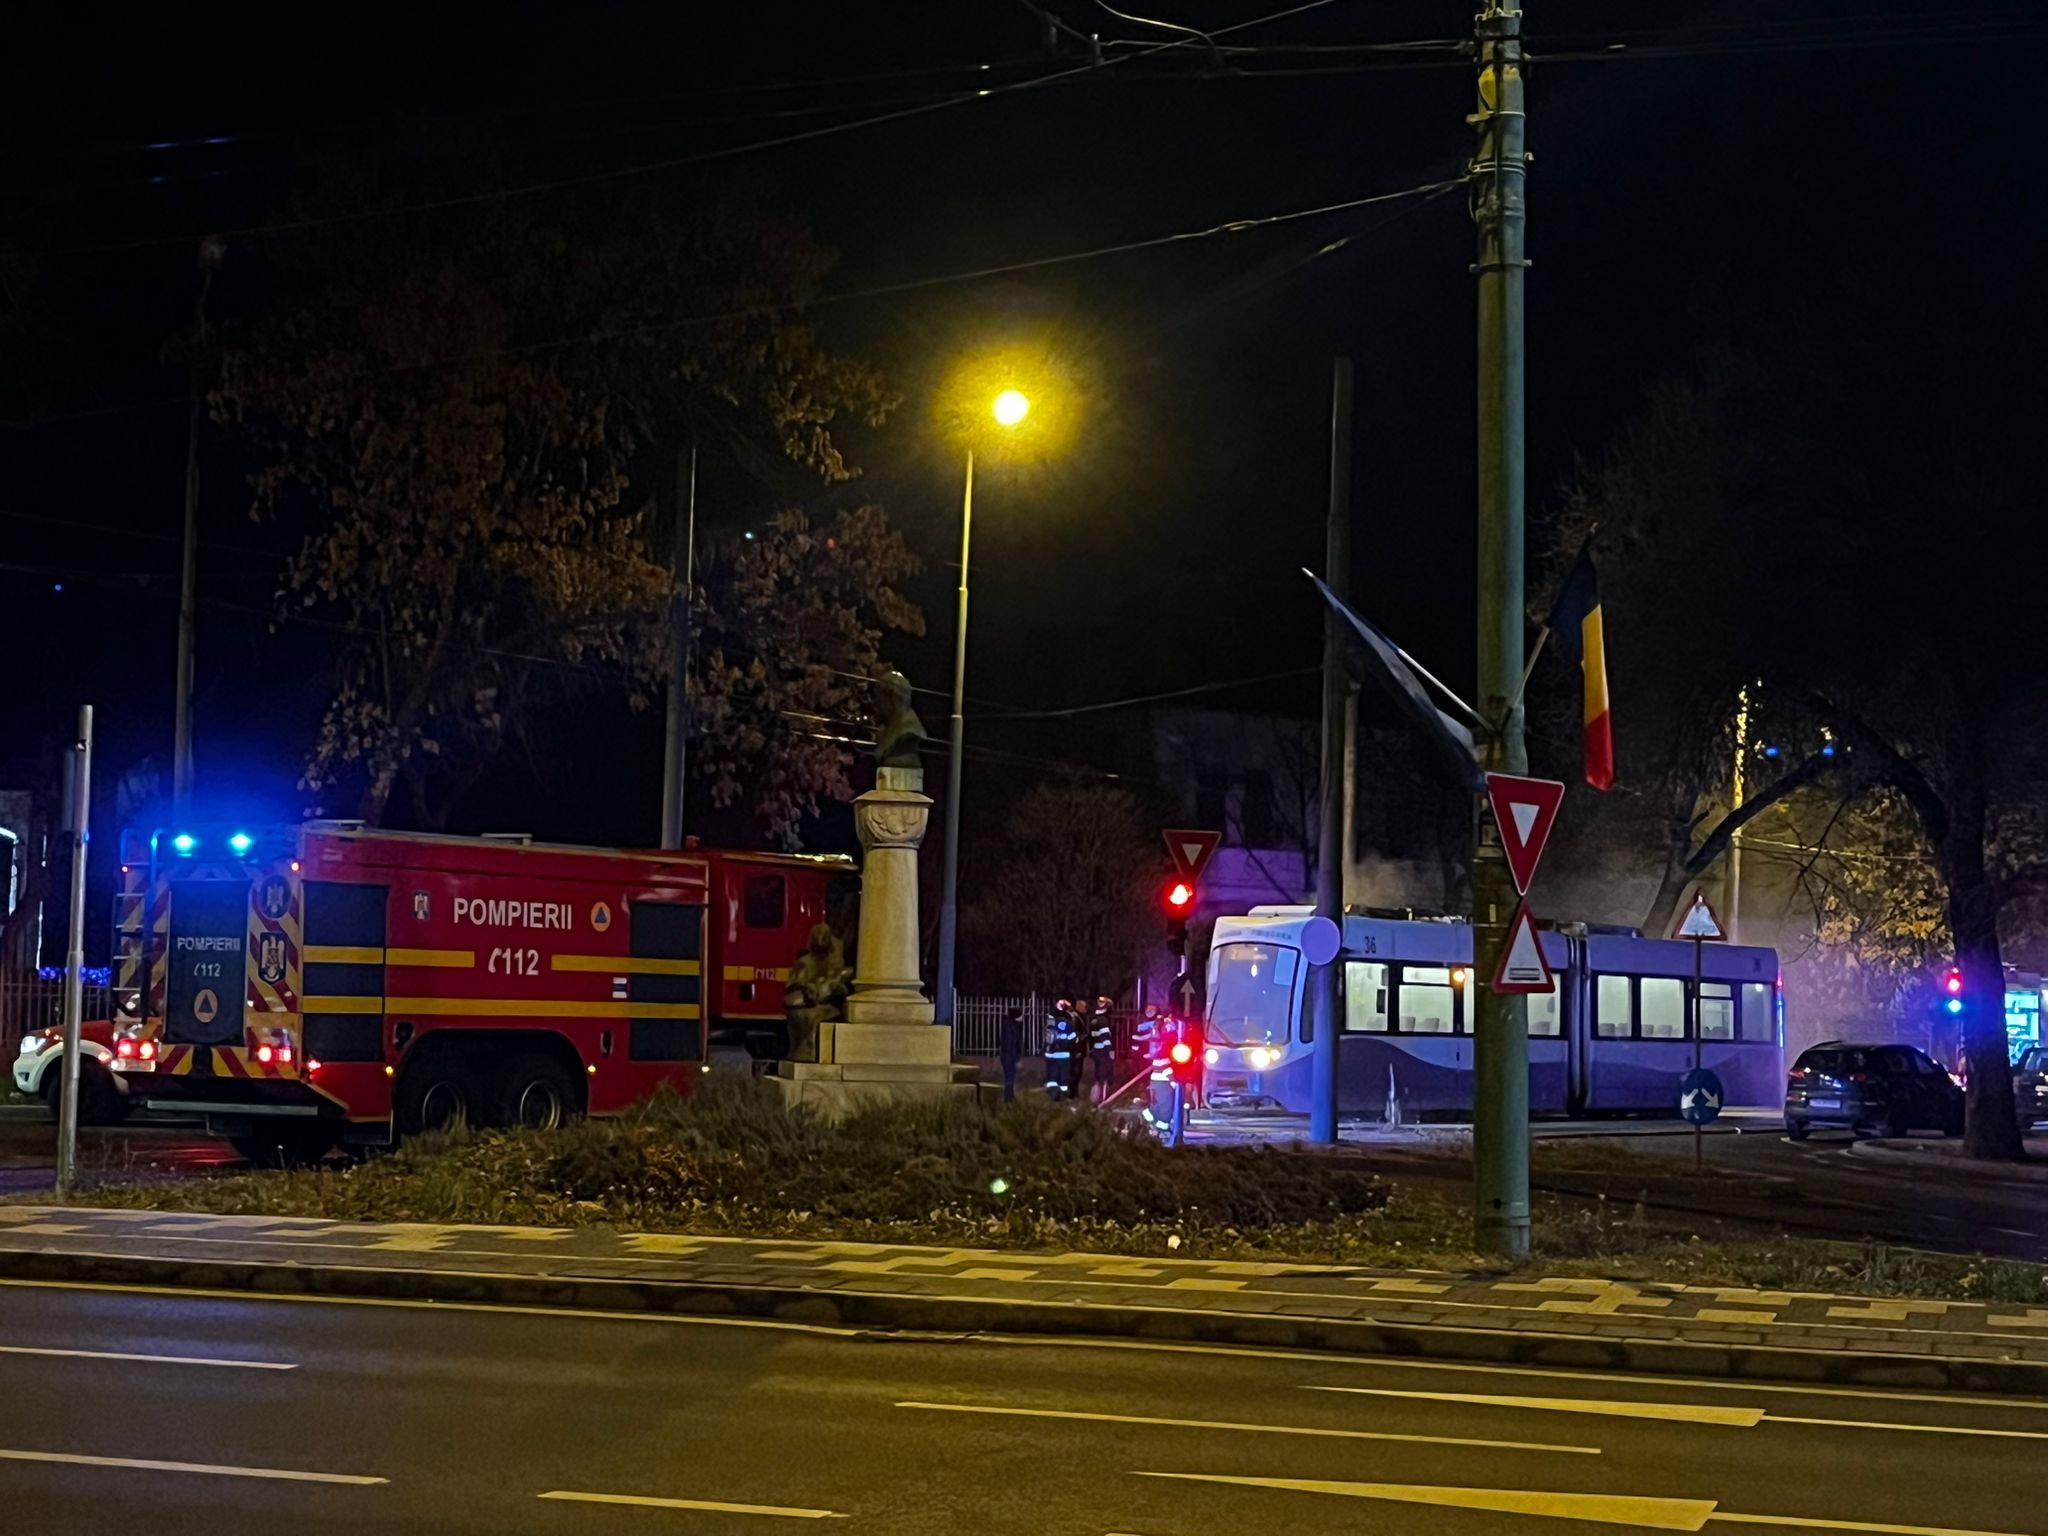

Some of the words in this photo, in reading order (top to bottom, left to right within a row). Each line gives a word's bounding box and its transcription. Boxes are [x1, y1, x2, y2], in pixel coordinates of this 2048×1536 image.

[454, 897, 571, 930] POMPIERII
[177, 937, 240, 951] POMPIERII
[1364, 935, 1376, 954] 36
[201, 963, 221, 977] 112
[502, 947, 539, 976] 112
